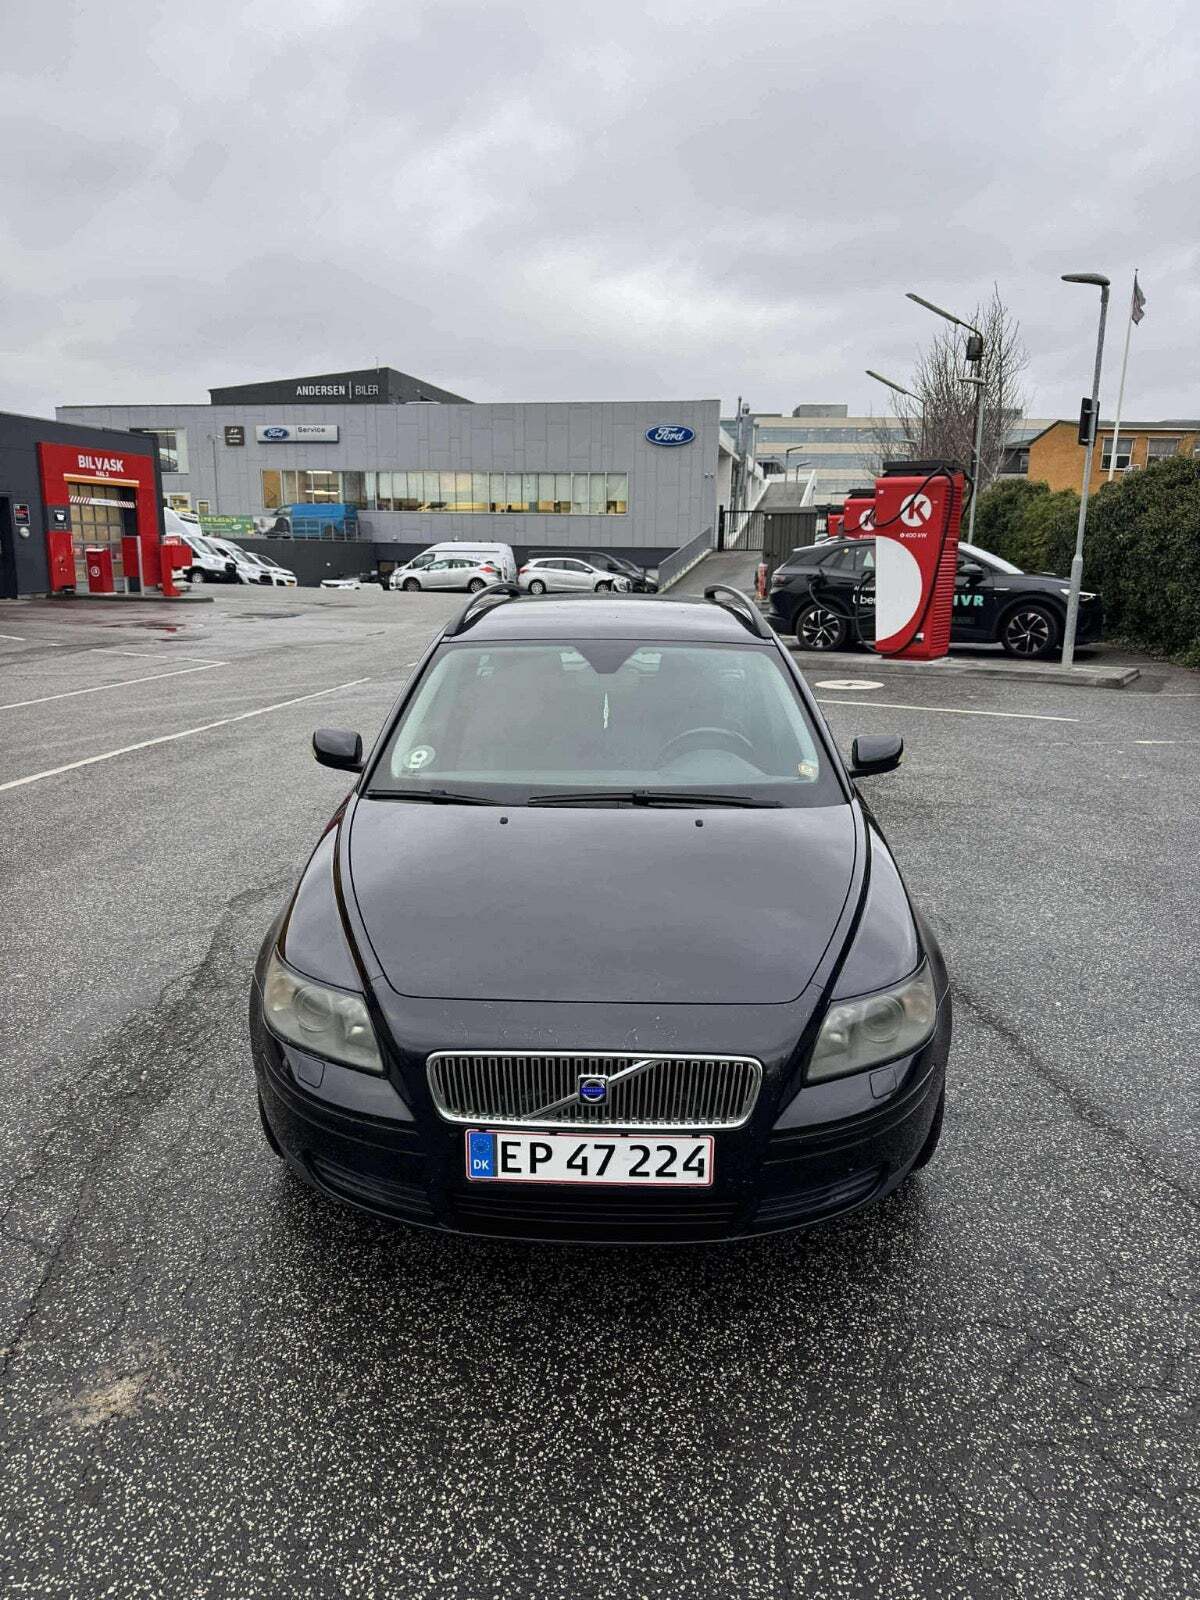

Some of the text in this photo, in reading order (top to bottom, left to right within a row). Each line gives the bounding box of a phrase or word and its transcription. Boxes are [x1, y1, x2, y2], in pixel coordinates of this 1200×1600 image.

[296, 384, 379, 396] ANDERSEN BILER
[267, 427, 285, 438] Ford
[655, 427, 686, 441] Ford
[78, 454, 125, 472] BILVASK
[473, 1159, 489, 1170] DK
[501, 1141, 705, 1179] EP 47 224
